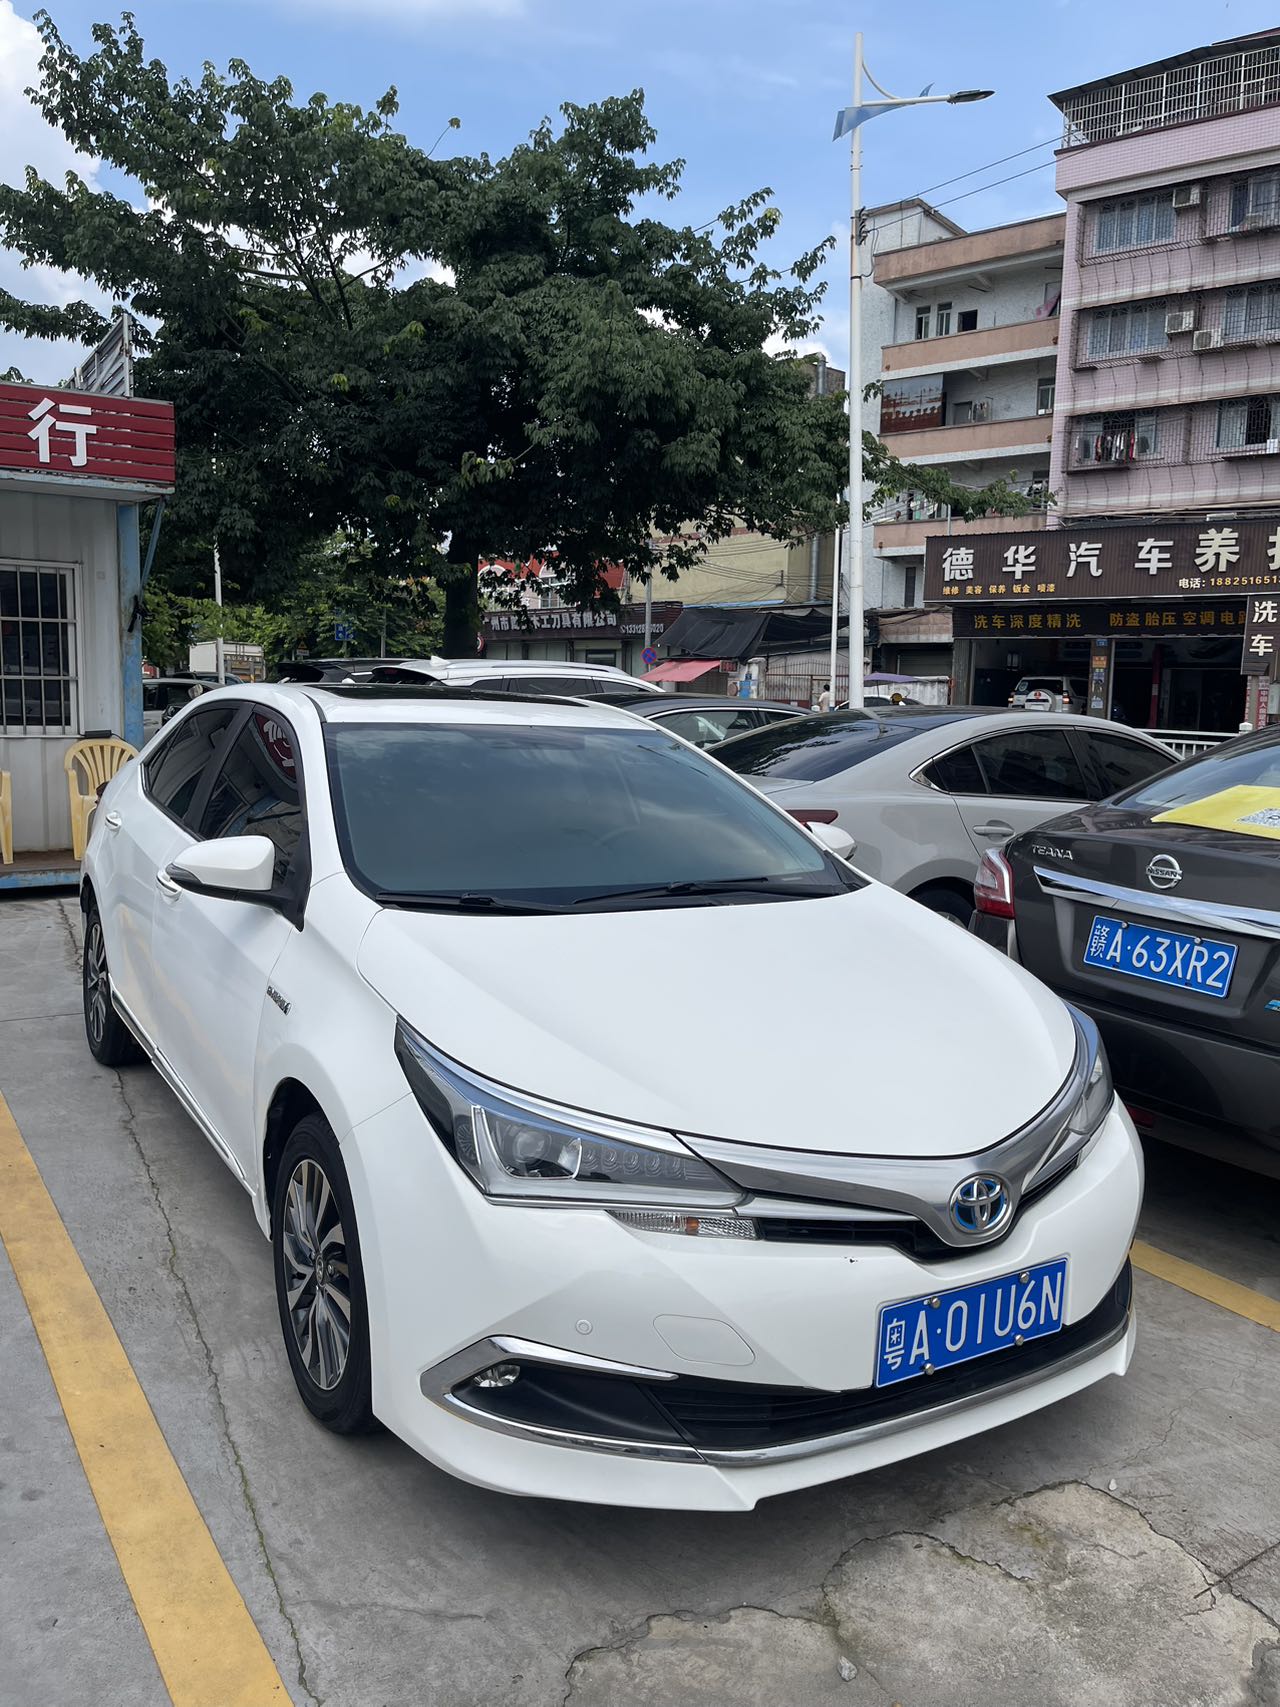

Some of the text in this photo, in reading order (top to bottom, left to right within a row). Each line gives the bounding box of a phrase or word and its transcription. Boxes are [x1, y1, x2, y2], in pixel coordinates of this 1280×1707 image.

[28, 397, 97, 467] 行
[989, 584, 1006, 594] 保养
[974, 613, 1082, 629] 洗车深度精洗
[1249, 600, 1278, 657] 洗车
[1032, 844, 1074, 861] TEANA
[1147, 866, 1179, 879] NISSAN
